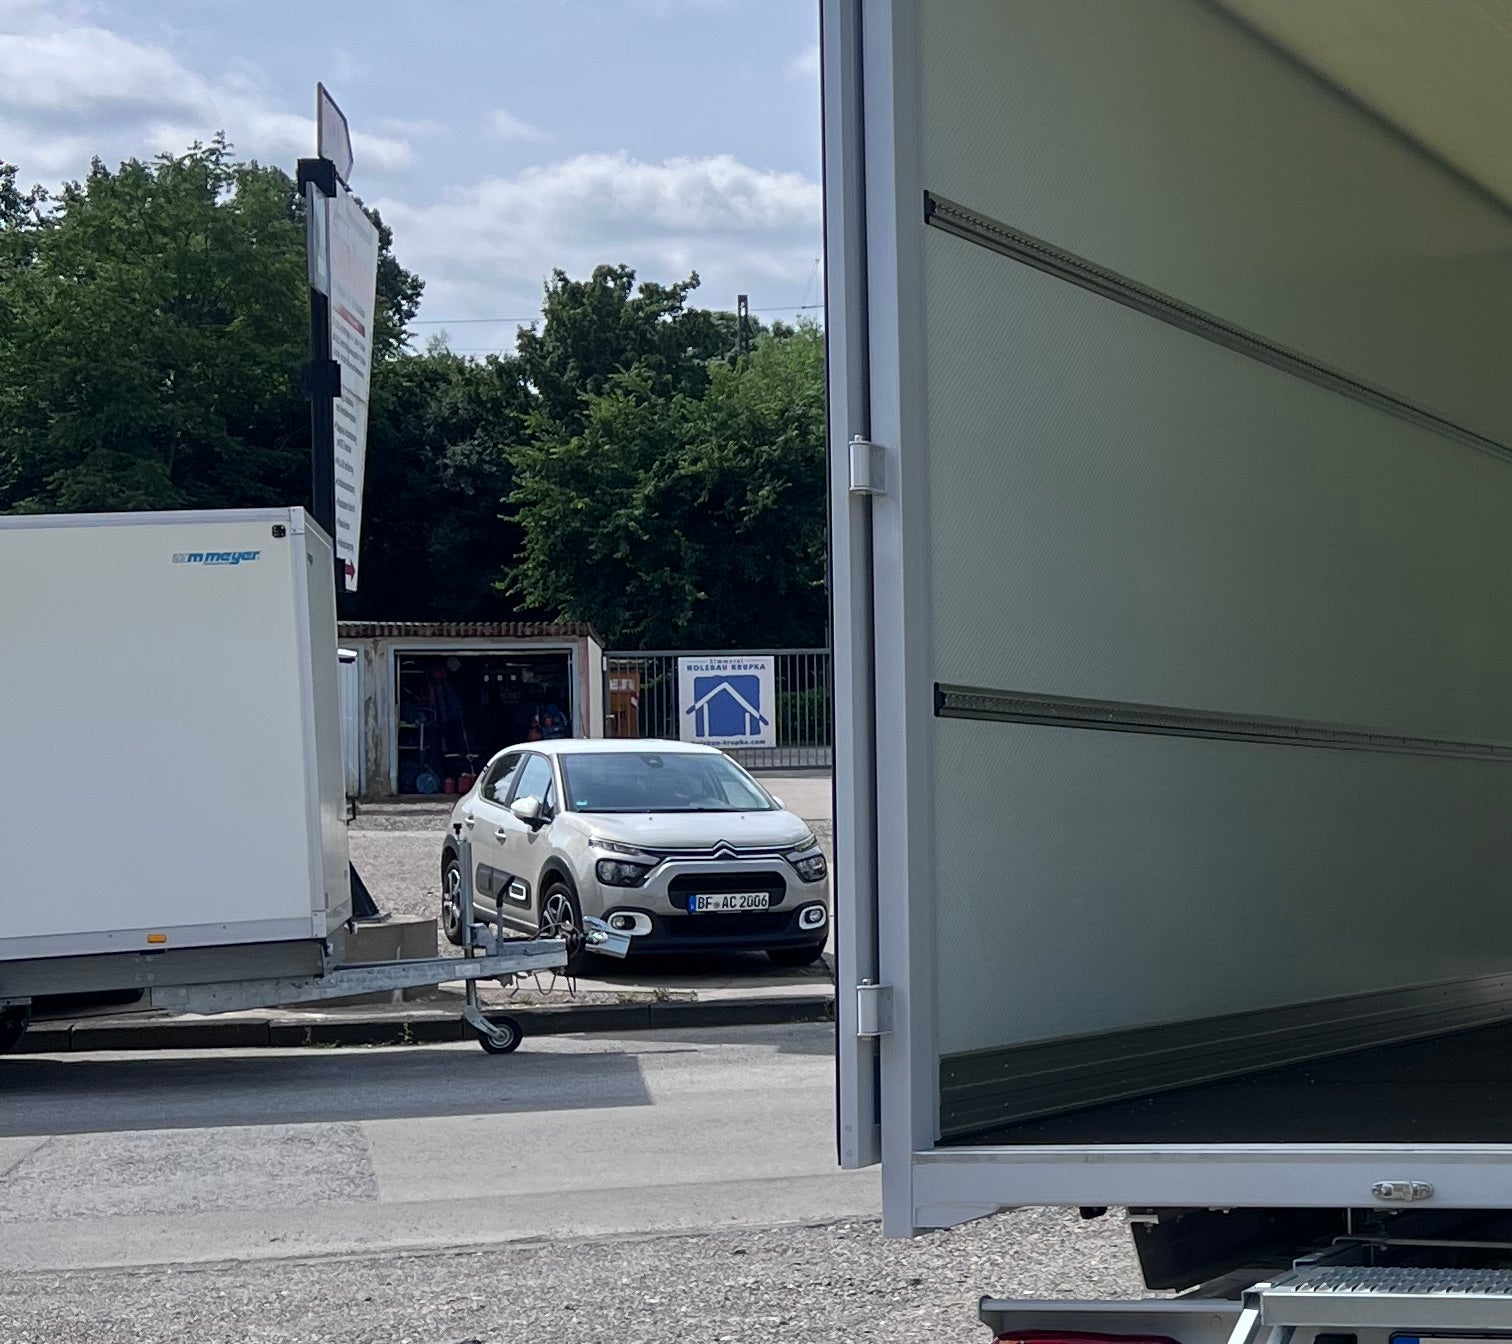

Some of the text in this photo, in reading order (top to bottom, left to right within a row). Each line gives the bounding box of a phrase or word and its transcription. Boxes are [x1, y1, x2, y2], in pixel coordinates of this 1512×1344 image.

[698, 895, 768, 910] BF AC 2006
